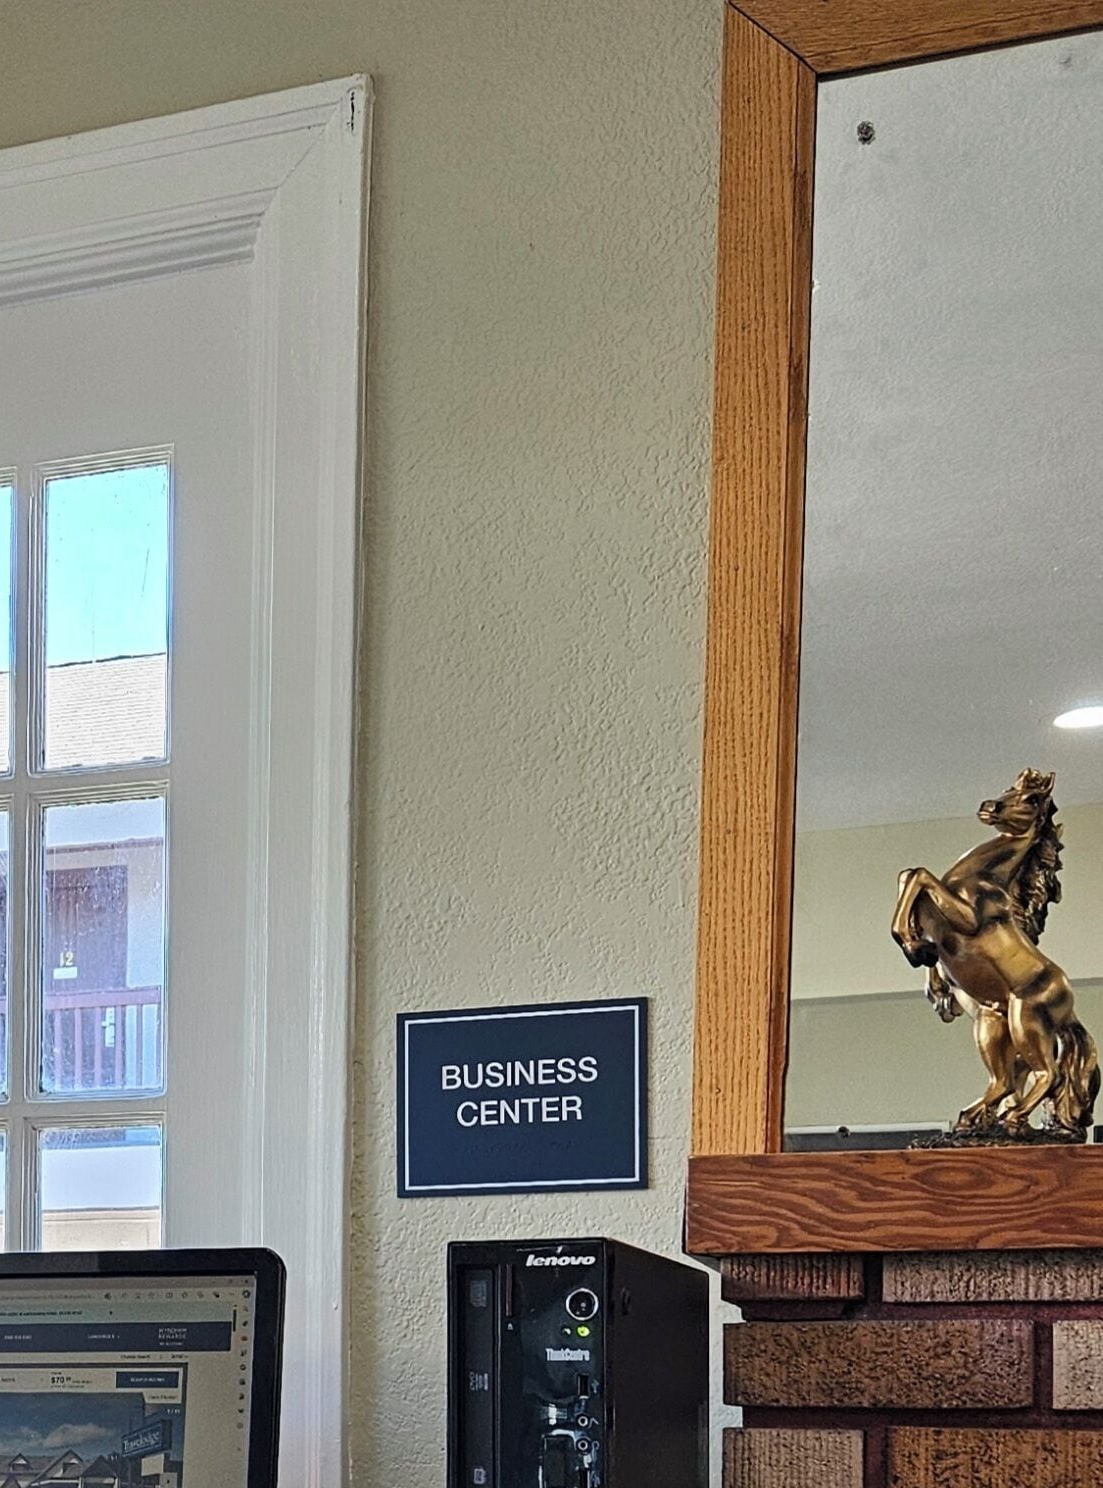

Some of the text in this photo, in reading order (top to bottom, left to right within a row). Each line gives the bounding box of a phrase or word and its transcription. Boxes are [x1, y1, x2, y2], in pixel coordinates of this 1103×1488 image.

[441, 1056, 599, 1090] BUSINESS
[456, 1095, 583, 1127] CENTER
[525, 1254, 596, 1267] lenovo
